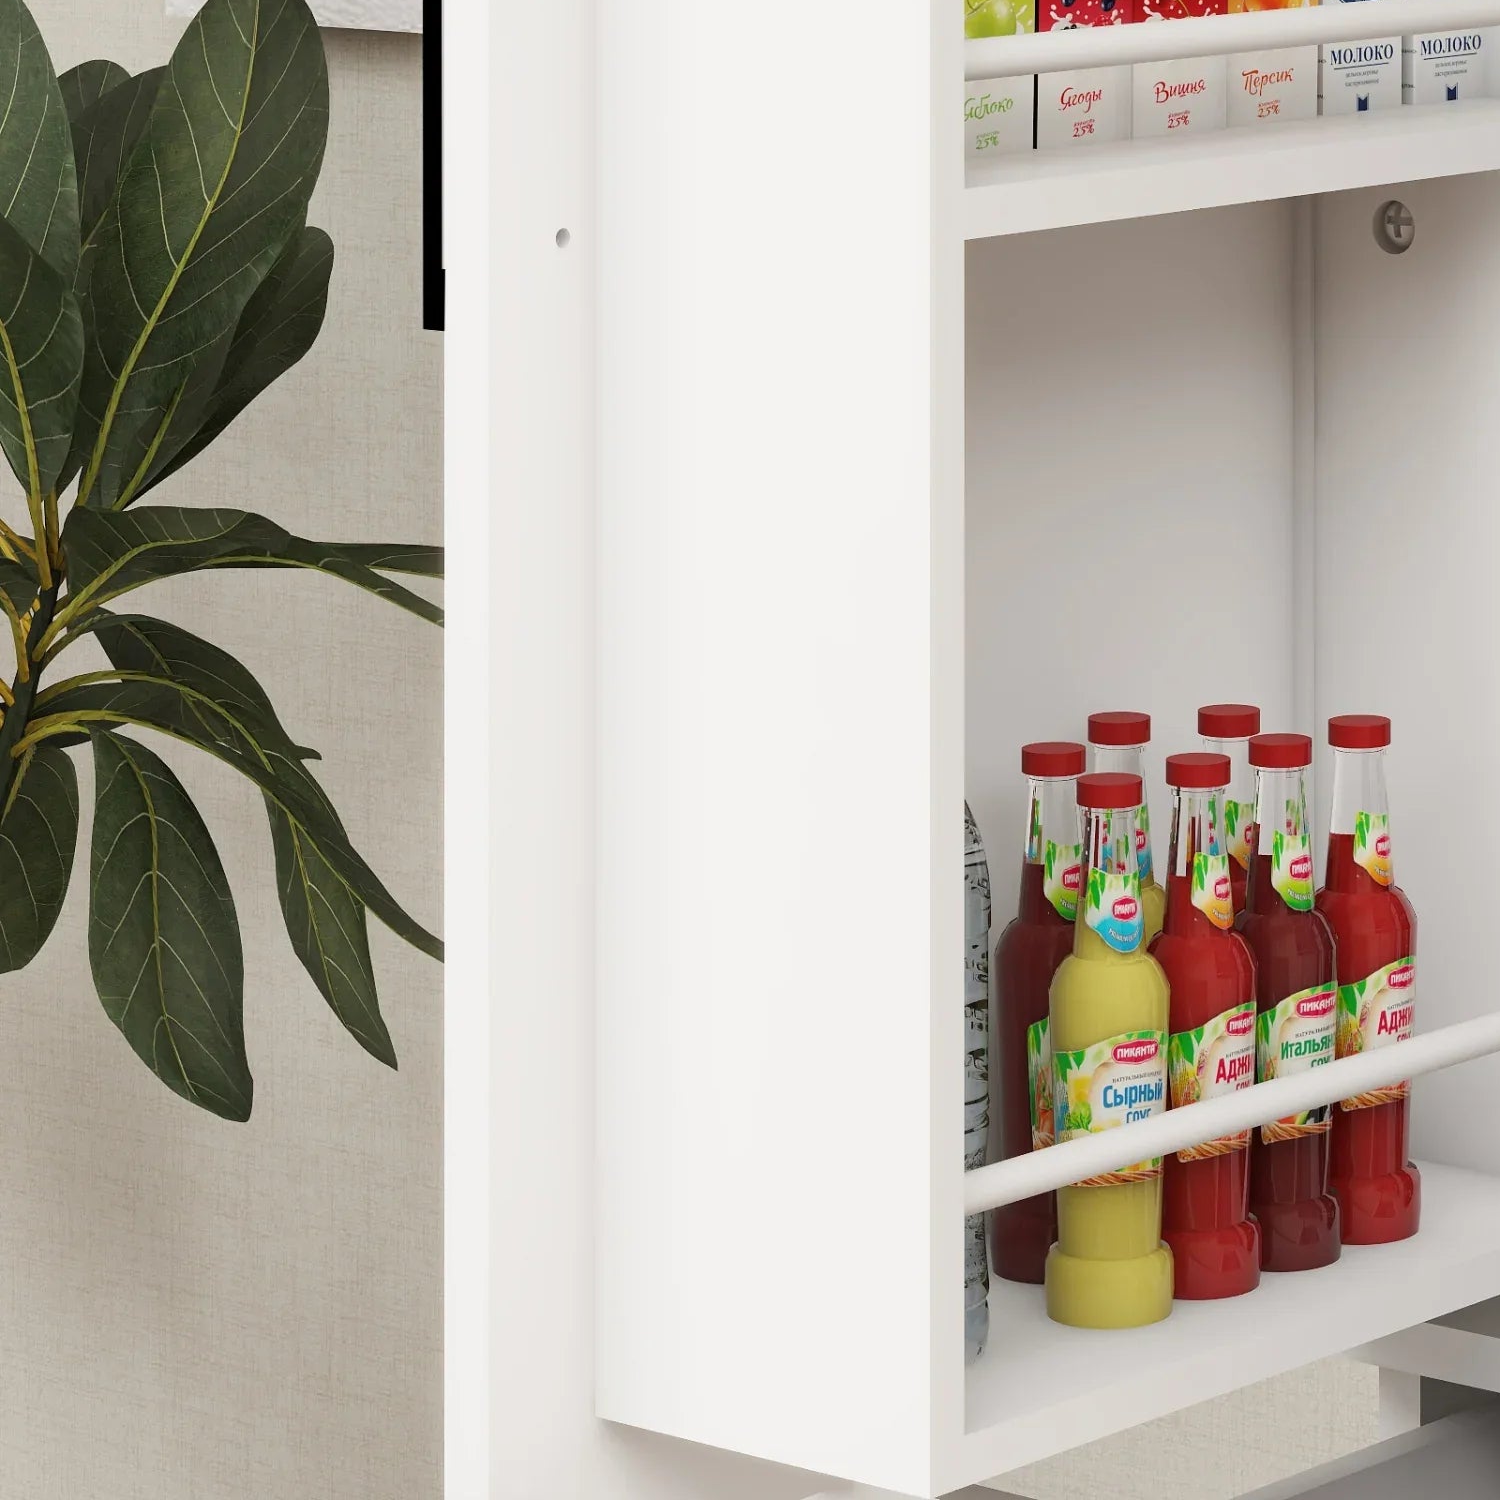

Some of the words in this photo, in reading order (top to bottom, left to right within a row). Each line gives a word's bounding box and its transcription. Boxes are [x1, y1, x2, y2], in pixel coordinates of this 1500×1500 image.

[1330, 43, 1394, 66] МОЛОКО
[1420, 34, 1482, 56] МОЛОКО
[1153, 79, 1206, 104] Вишня
[1241, 66, 1294, 97] Персик
[1058, 87, 1103, 113] Ягоды
[1117, 1044, 1156, 1059] ПИКАНТА
[1103, 1079, 1163, 1109] Сырный
